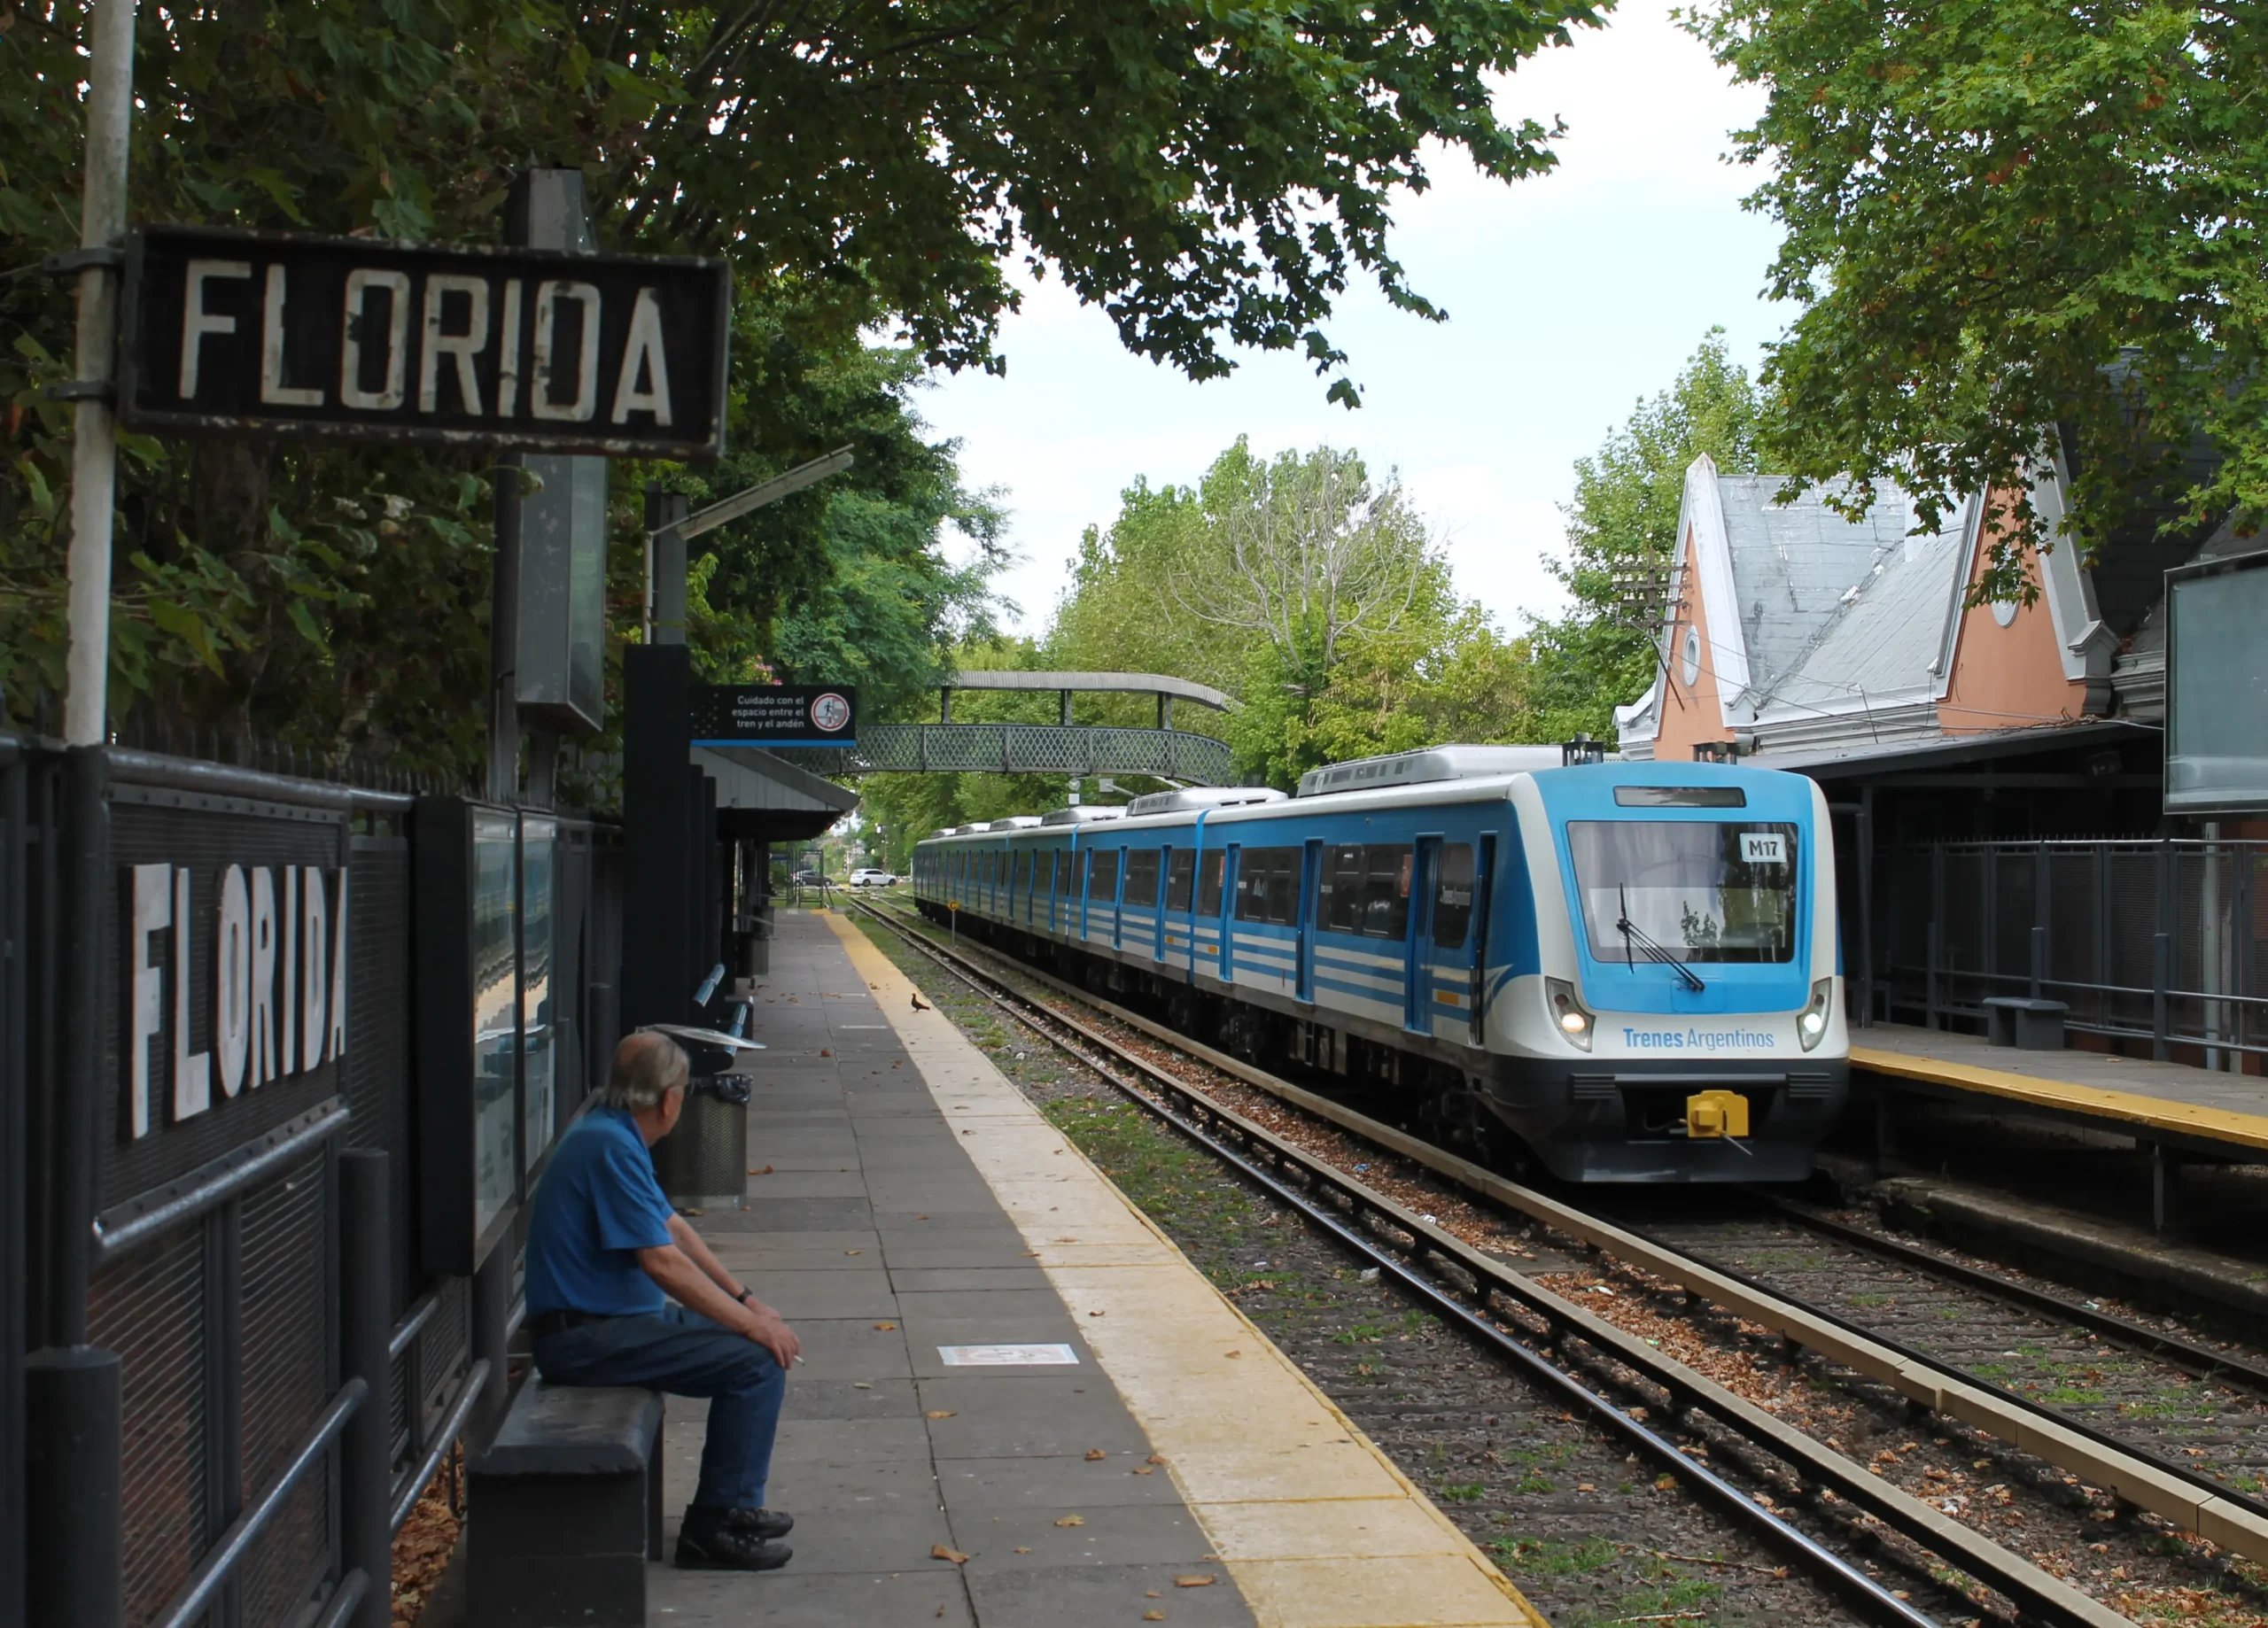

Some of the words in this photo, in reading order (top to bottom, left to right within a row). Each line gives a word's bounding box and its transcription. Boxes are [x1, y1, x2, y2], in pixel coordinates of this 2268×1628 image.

[179, 259, 673, 427] FLORIDA
[737, 695, 775, 705] Cuidado
[795, 695, 804, 705] el
[732, 708, 767, 717] espacio
[769, 708, 794, 717] entre
[795, 708, 804, 717] el
[737, 719, 756, 728] tren
[765, 719, 773, 728] el
[776, 718, 804, 728] andén
[1749, 840, 1778, 857] M17
[132, 863, 347, 1139] FLORIDA
[1622, 1027, 1684, 1049] Trenes
[1687, 1027, 1775, 1051] Argentinos
